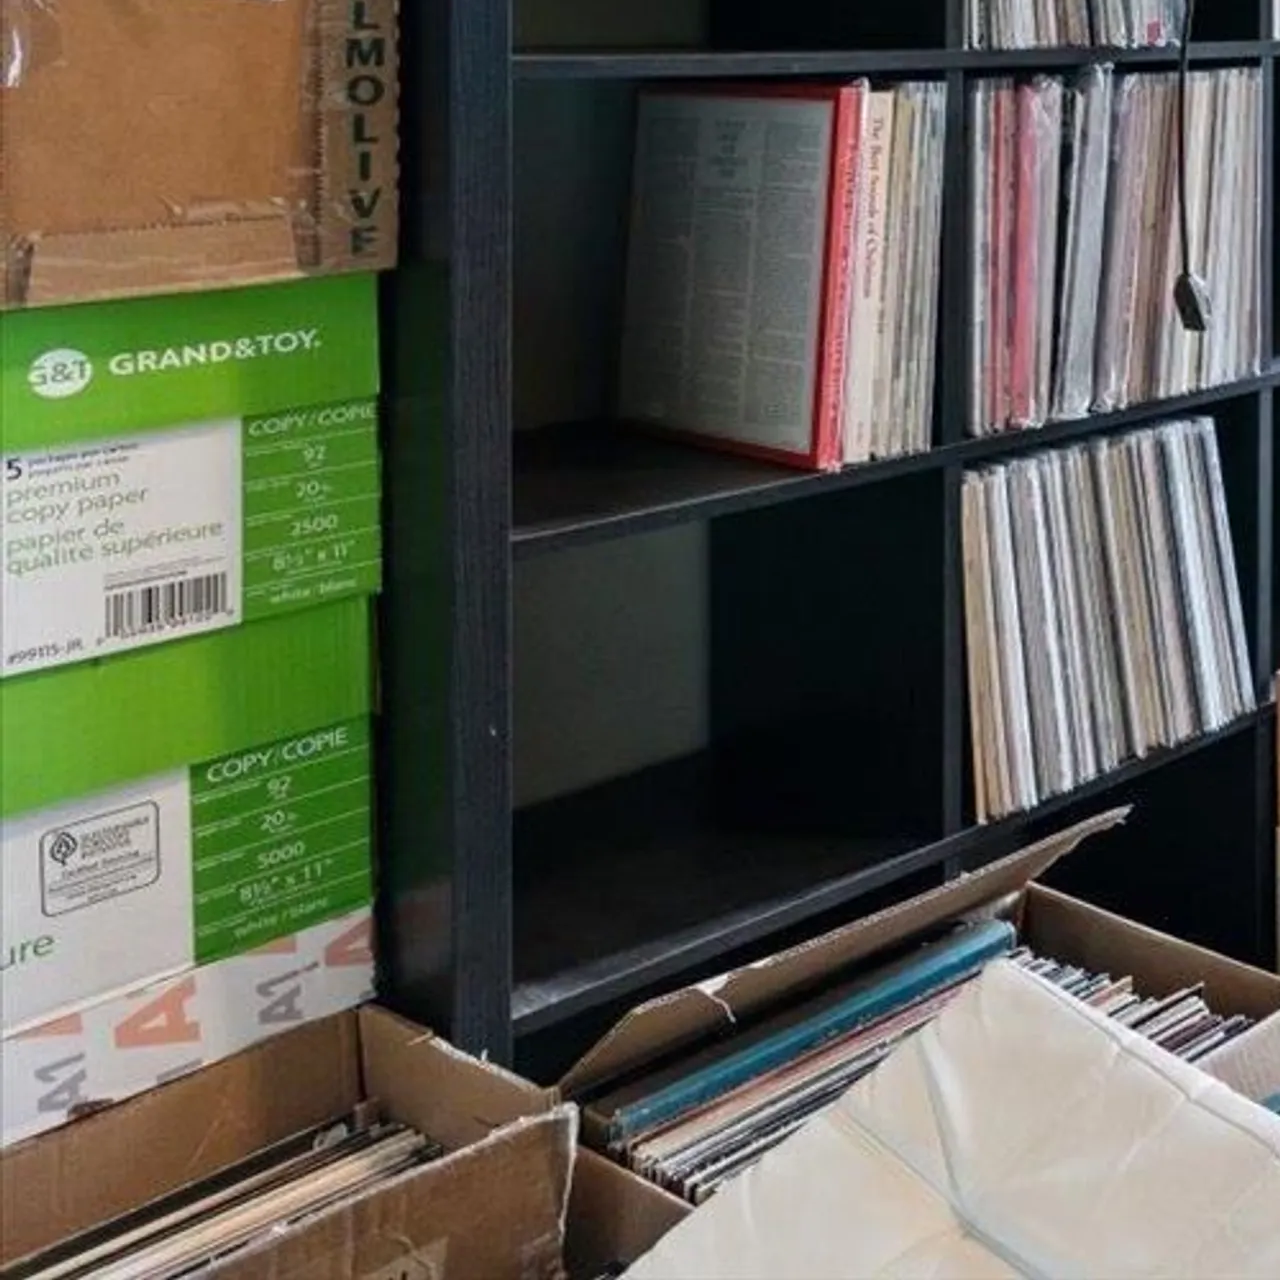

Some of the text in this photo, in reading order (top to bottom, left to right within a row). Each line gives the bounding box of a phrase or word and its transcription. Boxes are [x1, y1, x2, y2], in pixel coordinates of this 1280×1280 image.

[6, 458, 22, 480] 5
[6, 471, 120, 508] premium
[7, 487, 148, 524] copy paper
[6, 518, 125, 558] papier de
[257, 840, 306, 870] 5000
